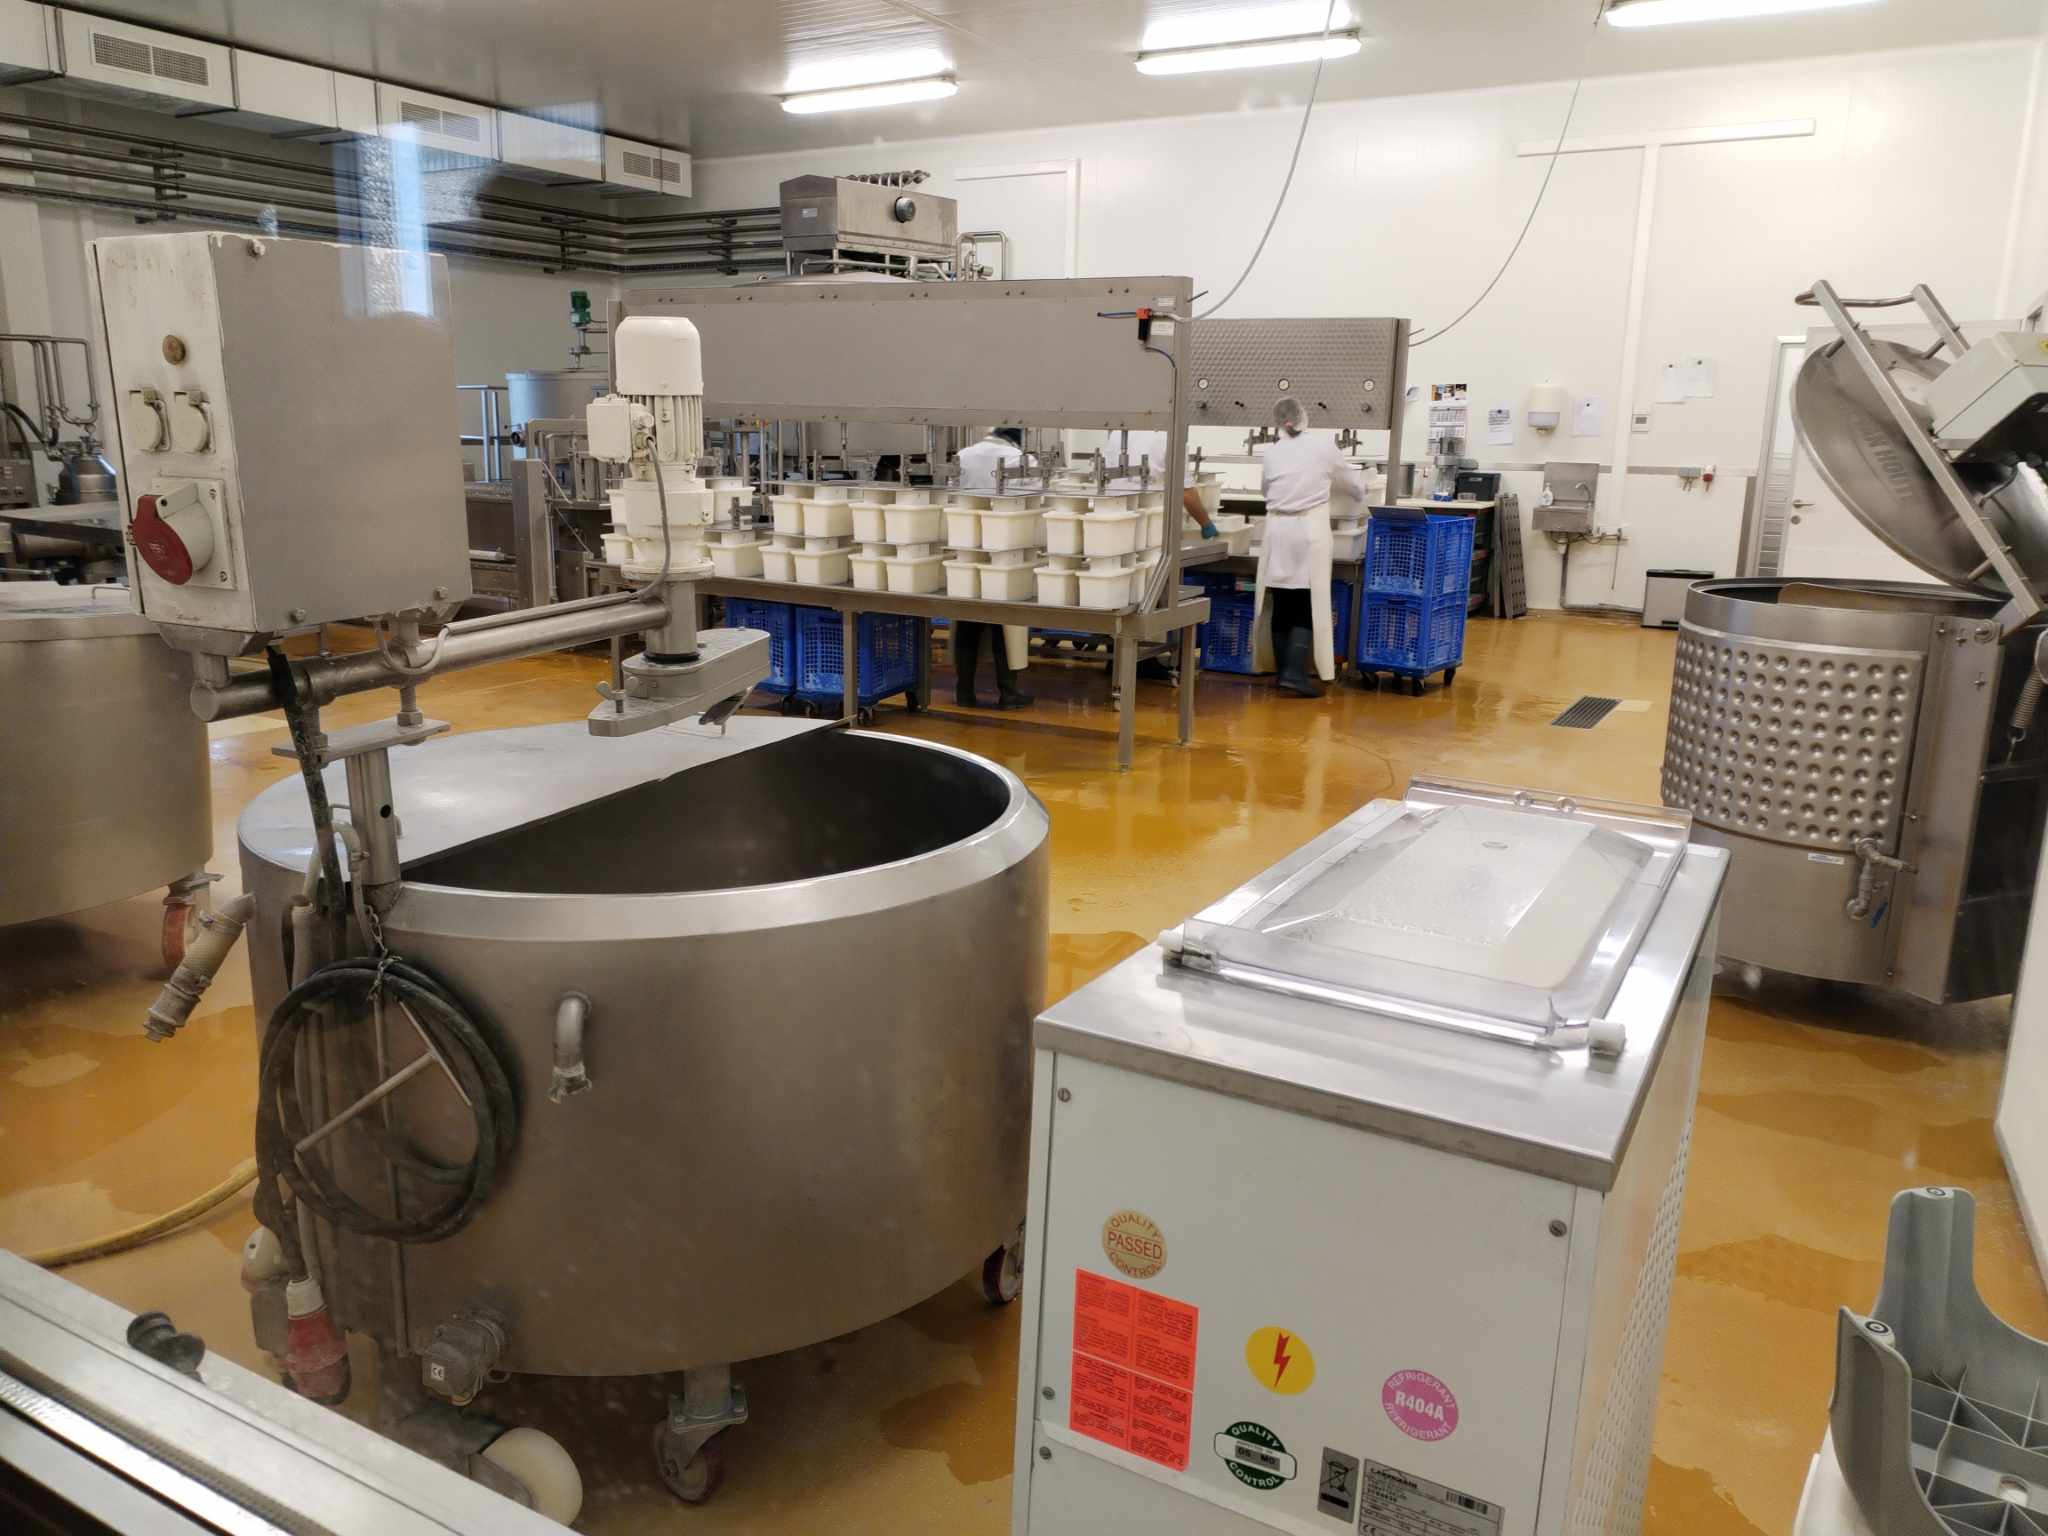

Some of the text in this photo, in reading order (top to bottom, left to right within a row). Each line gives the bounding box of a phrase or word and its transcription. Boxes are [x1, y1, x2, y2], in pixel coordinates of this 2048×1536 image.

[1110, 1213, 1159, 1239] QUALITY
[1107, 1230, 1162, 1260] PASSED
[1109, 1250, 1161, 1277] CONTROL
[1387, 1371, 1456, 1408] REFRIGERANT
[1394, 1390, 1444, 1421] R404A
[1231, 1424, 1280, 1447] QUALITY
[1229, 1462, 1280, 1487] CONTROL
